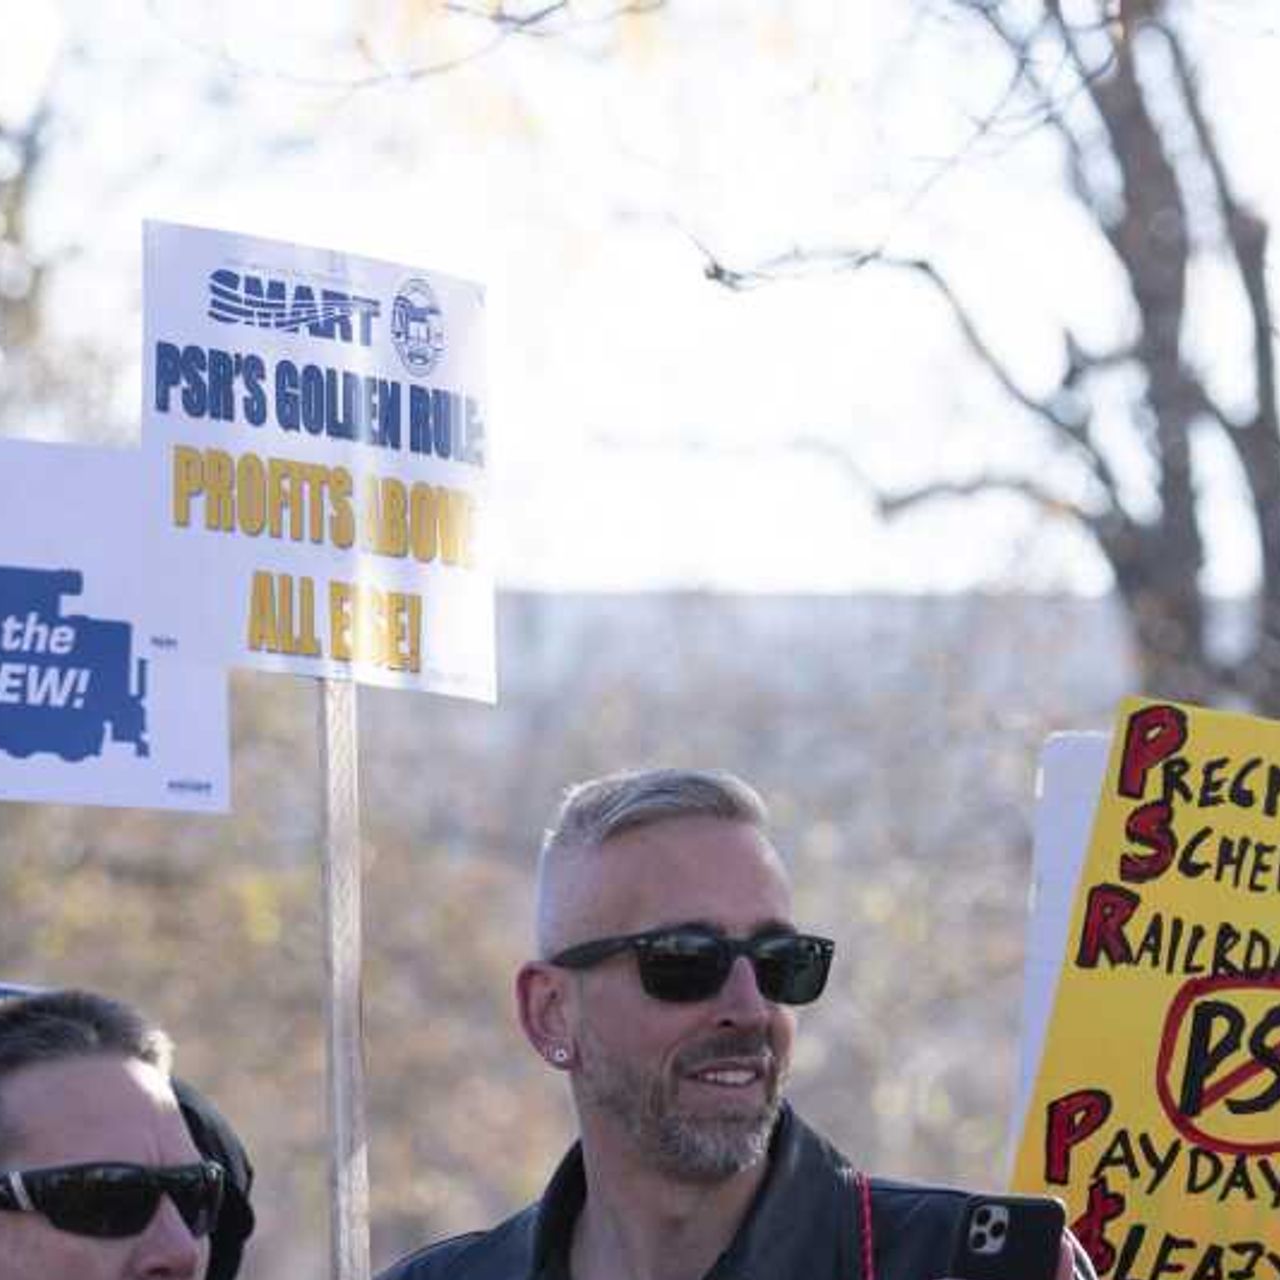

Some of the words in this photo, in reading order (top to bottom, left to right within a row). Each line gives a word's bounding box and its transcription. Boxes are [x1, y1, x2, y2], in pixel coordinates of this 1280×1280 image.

[208, 269, 380, 346] SMART
[155, 341, 266, 427] PSR'S
[173, 447, 355, 550] PROFITS
[2, 613, 75, 654] the
[248, 570, 322, 658] ALL
[329, 580, 422, 672] EE!
